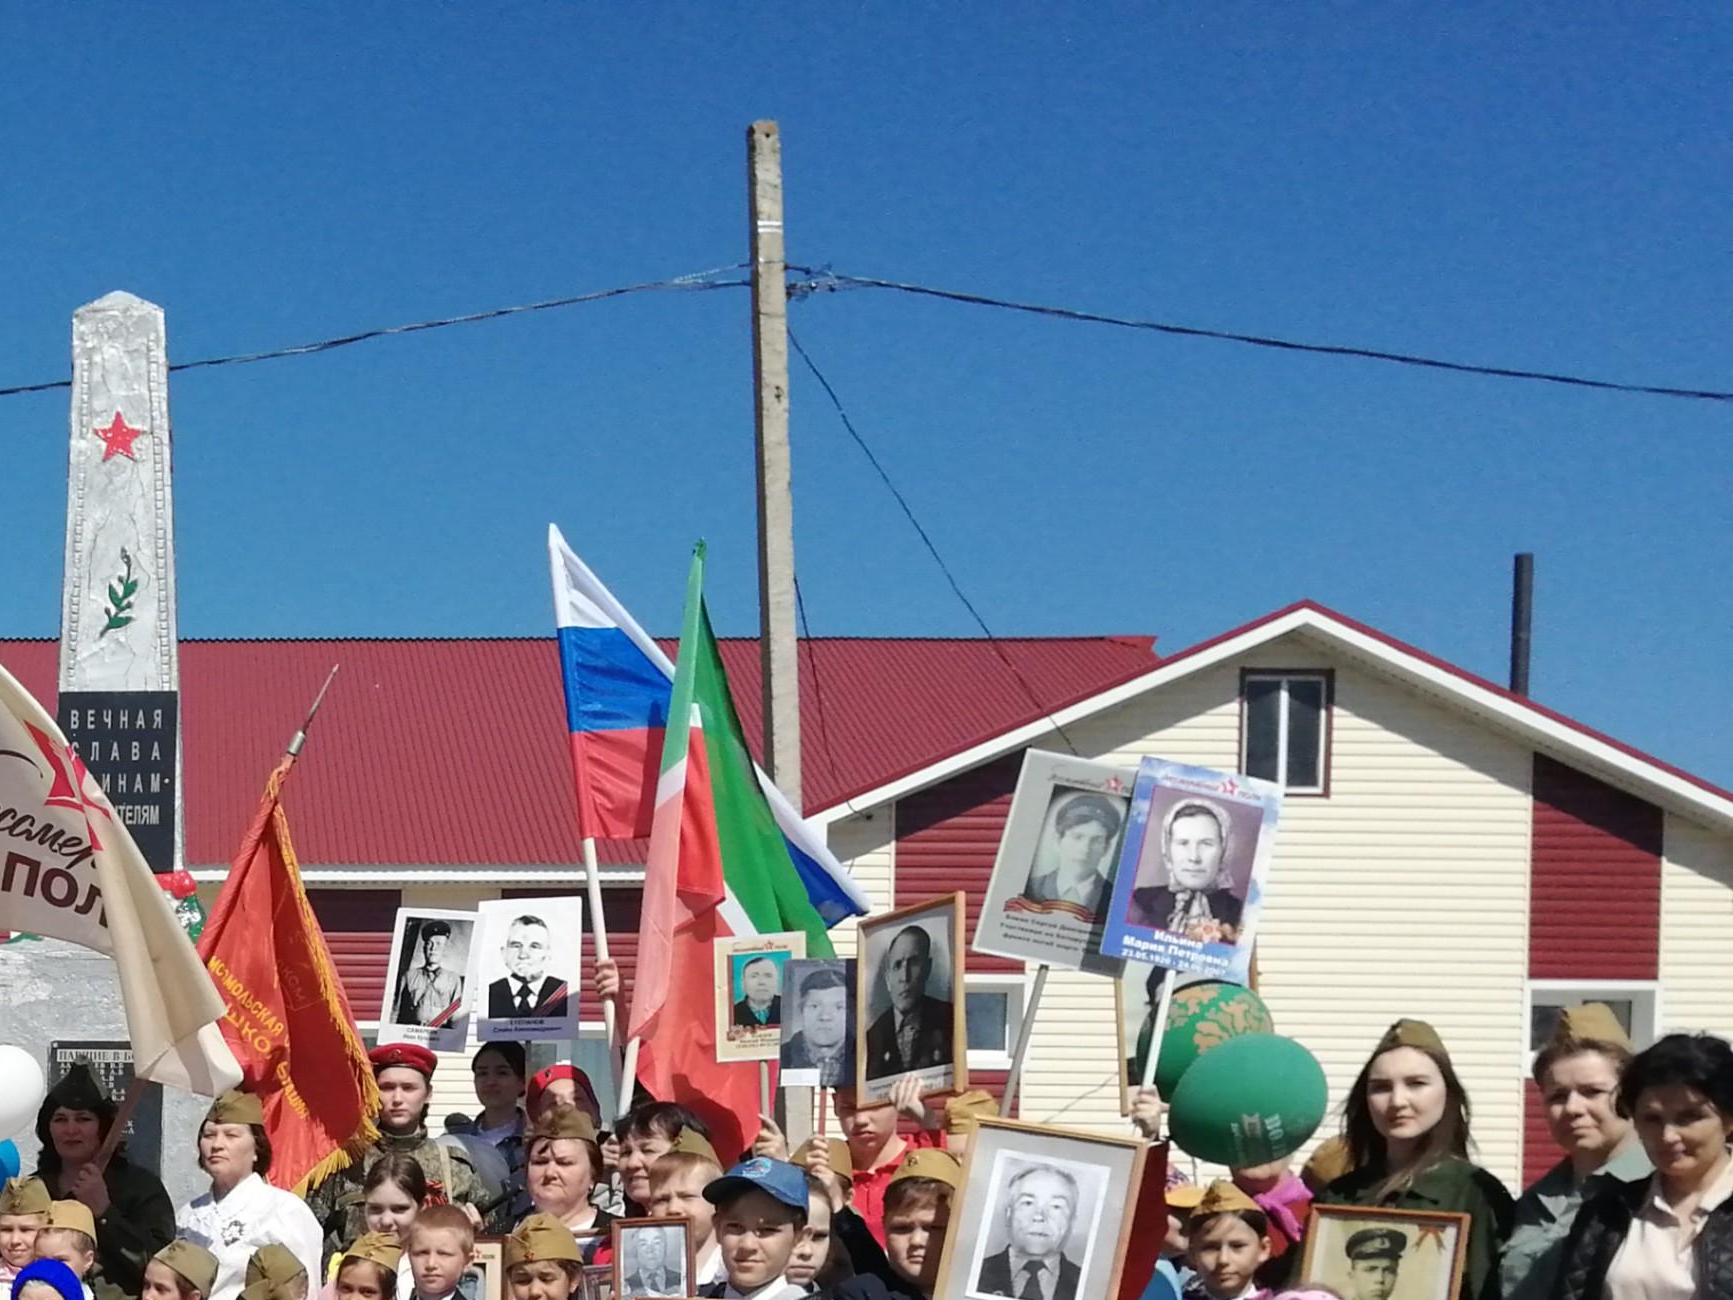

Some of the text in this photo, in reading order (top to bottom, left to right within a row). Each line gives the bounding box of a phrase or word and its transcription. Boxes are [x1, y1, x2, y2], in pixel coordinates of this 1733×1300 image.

[70, 708, 163, 730] ВЕЧНАЯ
[101, 772, 161, 793] ИНАМ
[1123, 934, 1229, 967] Мария Петровна
